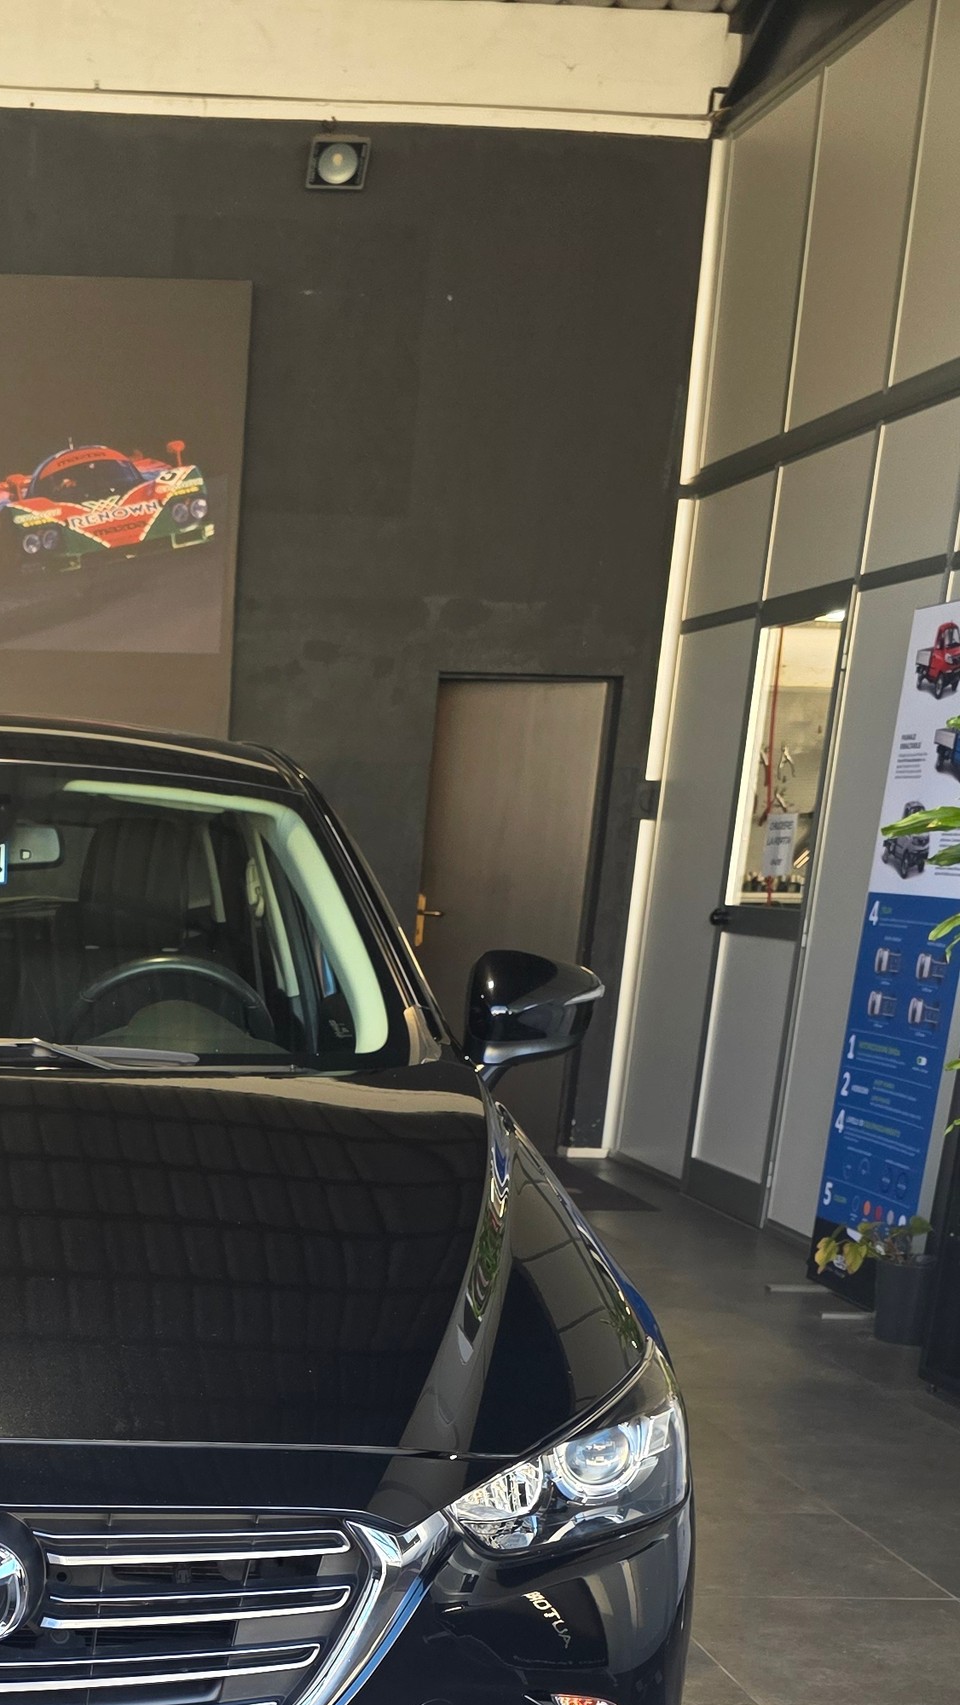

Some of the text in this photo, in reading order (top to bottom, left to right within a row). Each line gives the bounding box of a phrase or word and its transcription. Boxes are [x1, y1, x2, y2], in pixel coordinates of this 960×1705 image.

[71, 502, 158, 527] RENOWN
[868, 900, 880, 926] 4
[847, 1034, 856, 1060] 1
[840, 1072, 851, 1096] 2
[835, 1109, 845, 1133] 4
[823, 1182, 833, 1206] 5
